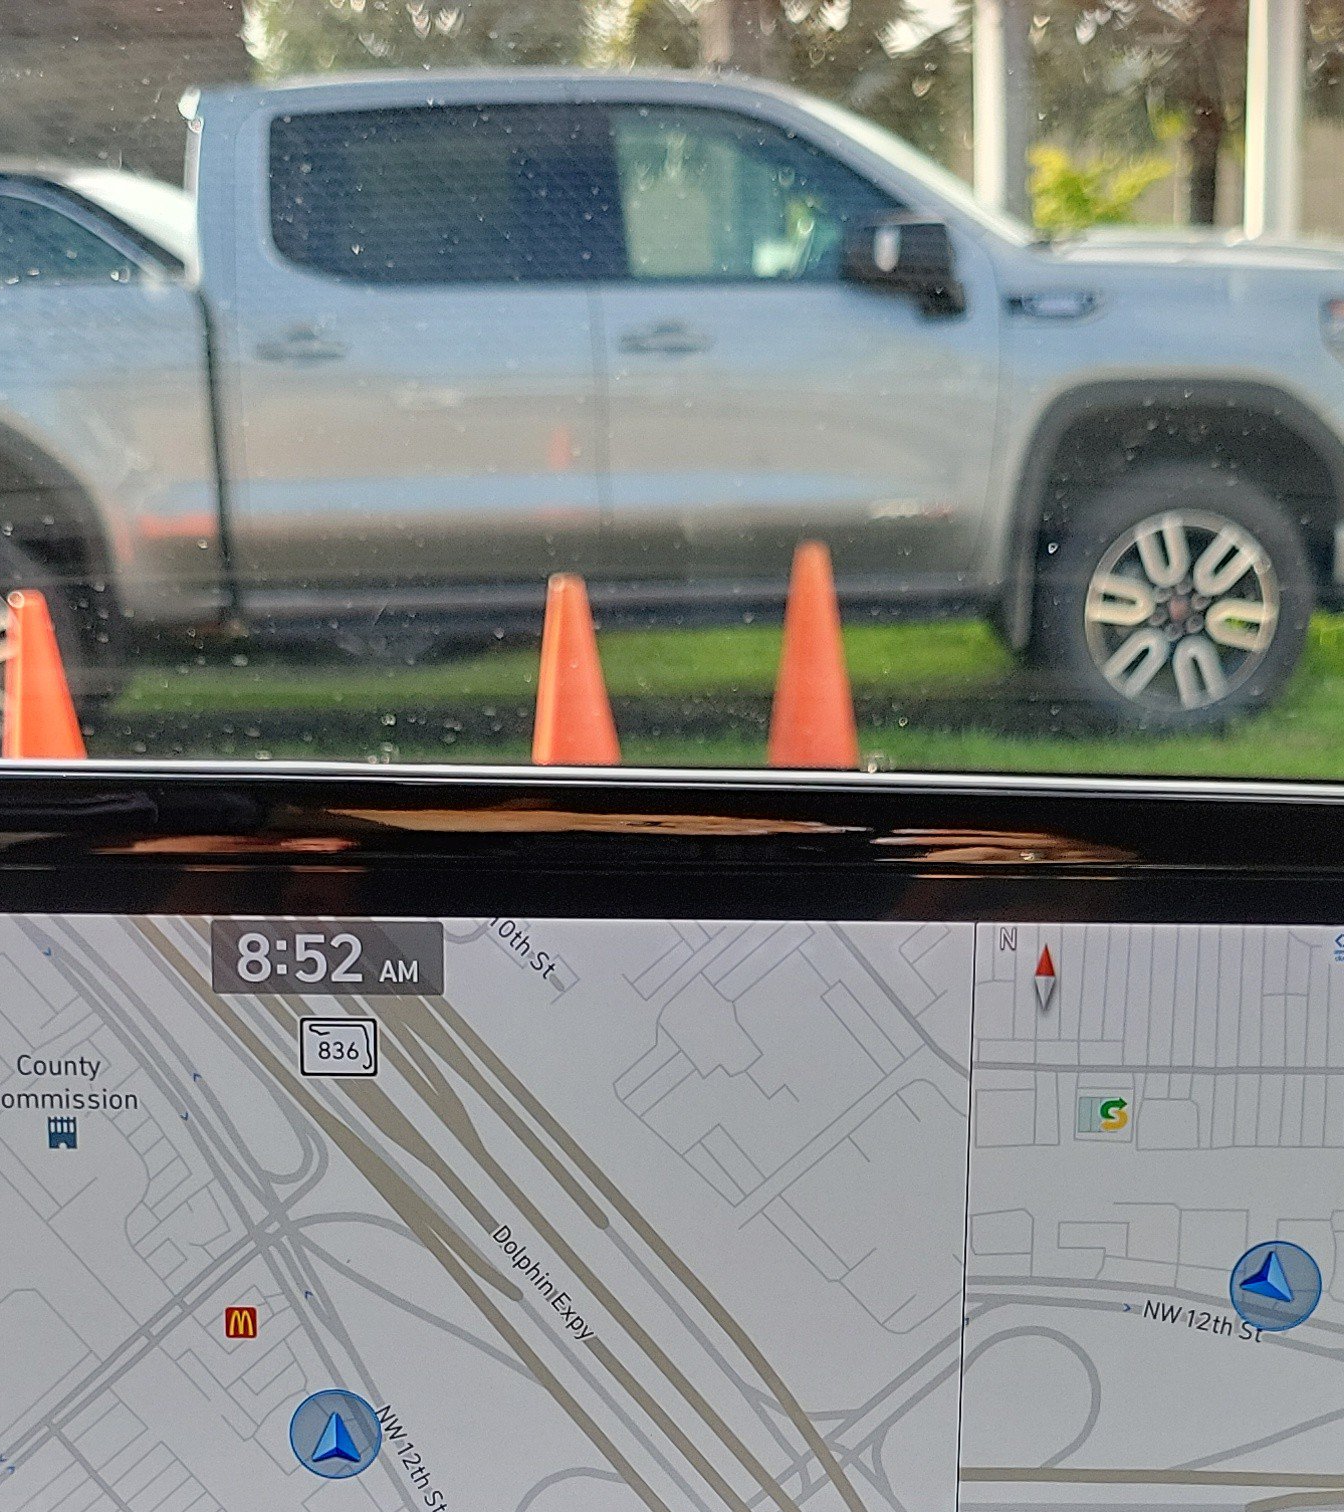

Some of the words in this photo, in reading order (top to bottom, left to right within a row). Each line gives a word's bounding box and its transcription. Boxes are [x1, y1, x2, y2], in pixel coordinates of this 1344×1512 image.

[999, 926, 1017, 951] N
[236, 933, 363, 984] 8:52
[379, 962, 420, 984] AM
[530, 951, 556, 980] St
[16, 1054, 101, 1081] County
[318, 1042, 360, 1061] 836
[492, 1224, 555, 1295] Dolphin
[550, 1291, 596, 1342] Expy
[1142, 1300, 1180, 1325] NW
[1185, 1309, 1235, 1338] 12th
[1237, 1320, 1264, 1344] St
[376, 1403, 406, 1441] NW
[396, 1438, 433, 1491] 12th
